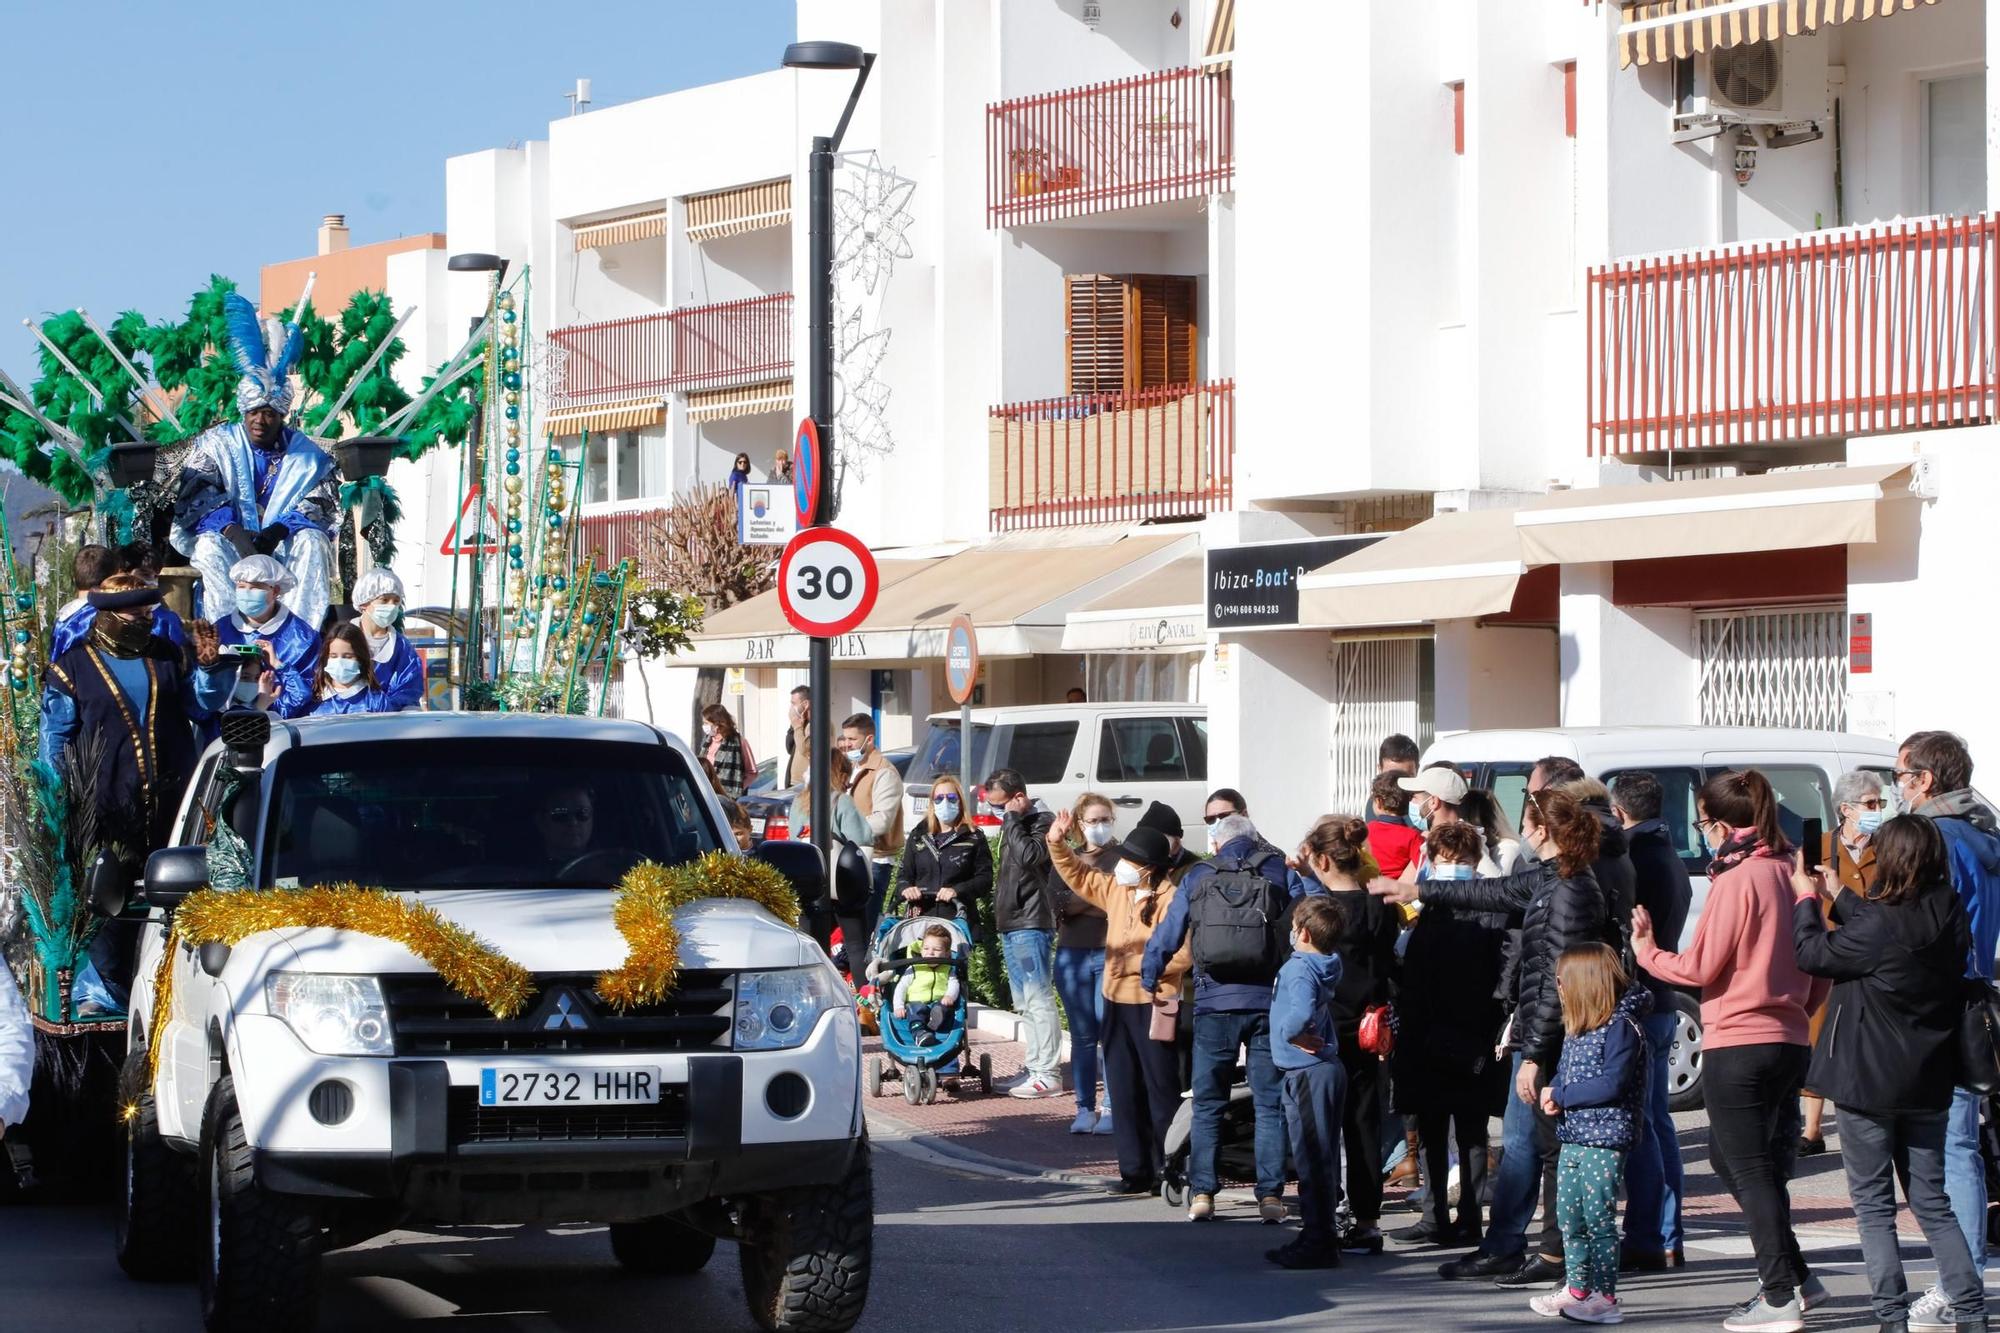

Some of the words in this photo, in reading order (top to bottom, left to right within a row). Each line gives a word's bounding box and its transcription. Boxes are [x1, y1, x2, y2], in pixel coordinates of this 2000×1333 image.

[797, 566, 853, 600] 30
[1214, 566, 1312, 590] Ibiza-Boat-
[1224, 605, 1239, 616] (+34)
[1253, 605, 1266, 614] 949
[1267, 605, 1279, 614] 283
[746, 638, 774, 660] BAR
[806, 634, 866, 658] PLEX
[486, 1090, 492, 1099] E
[502, 1073, 581, 1101] 2732
[594, 1072, 651, 1100] HHR
